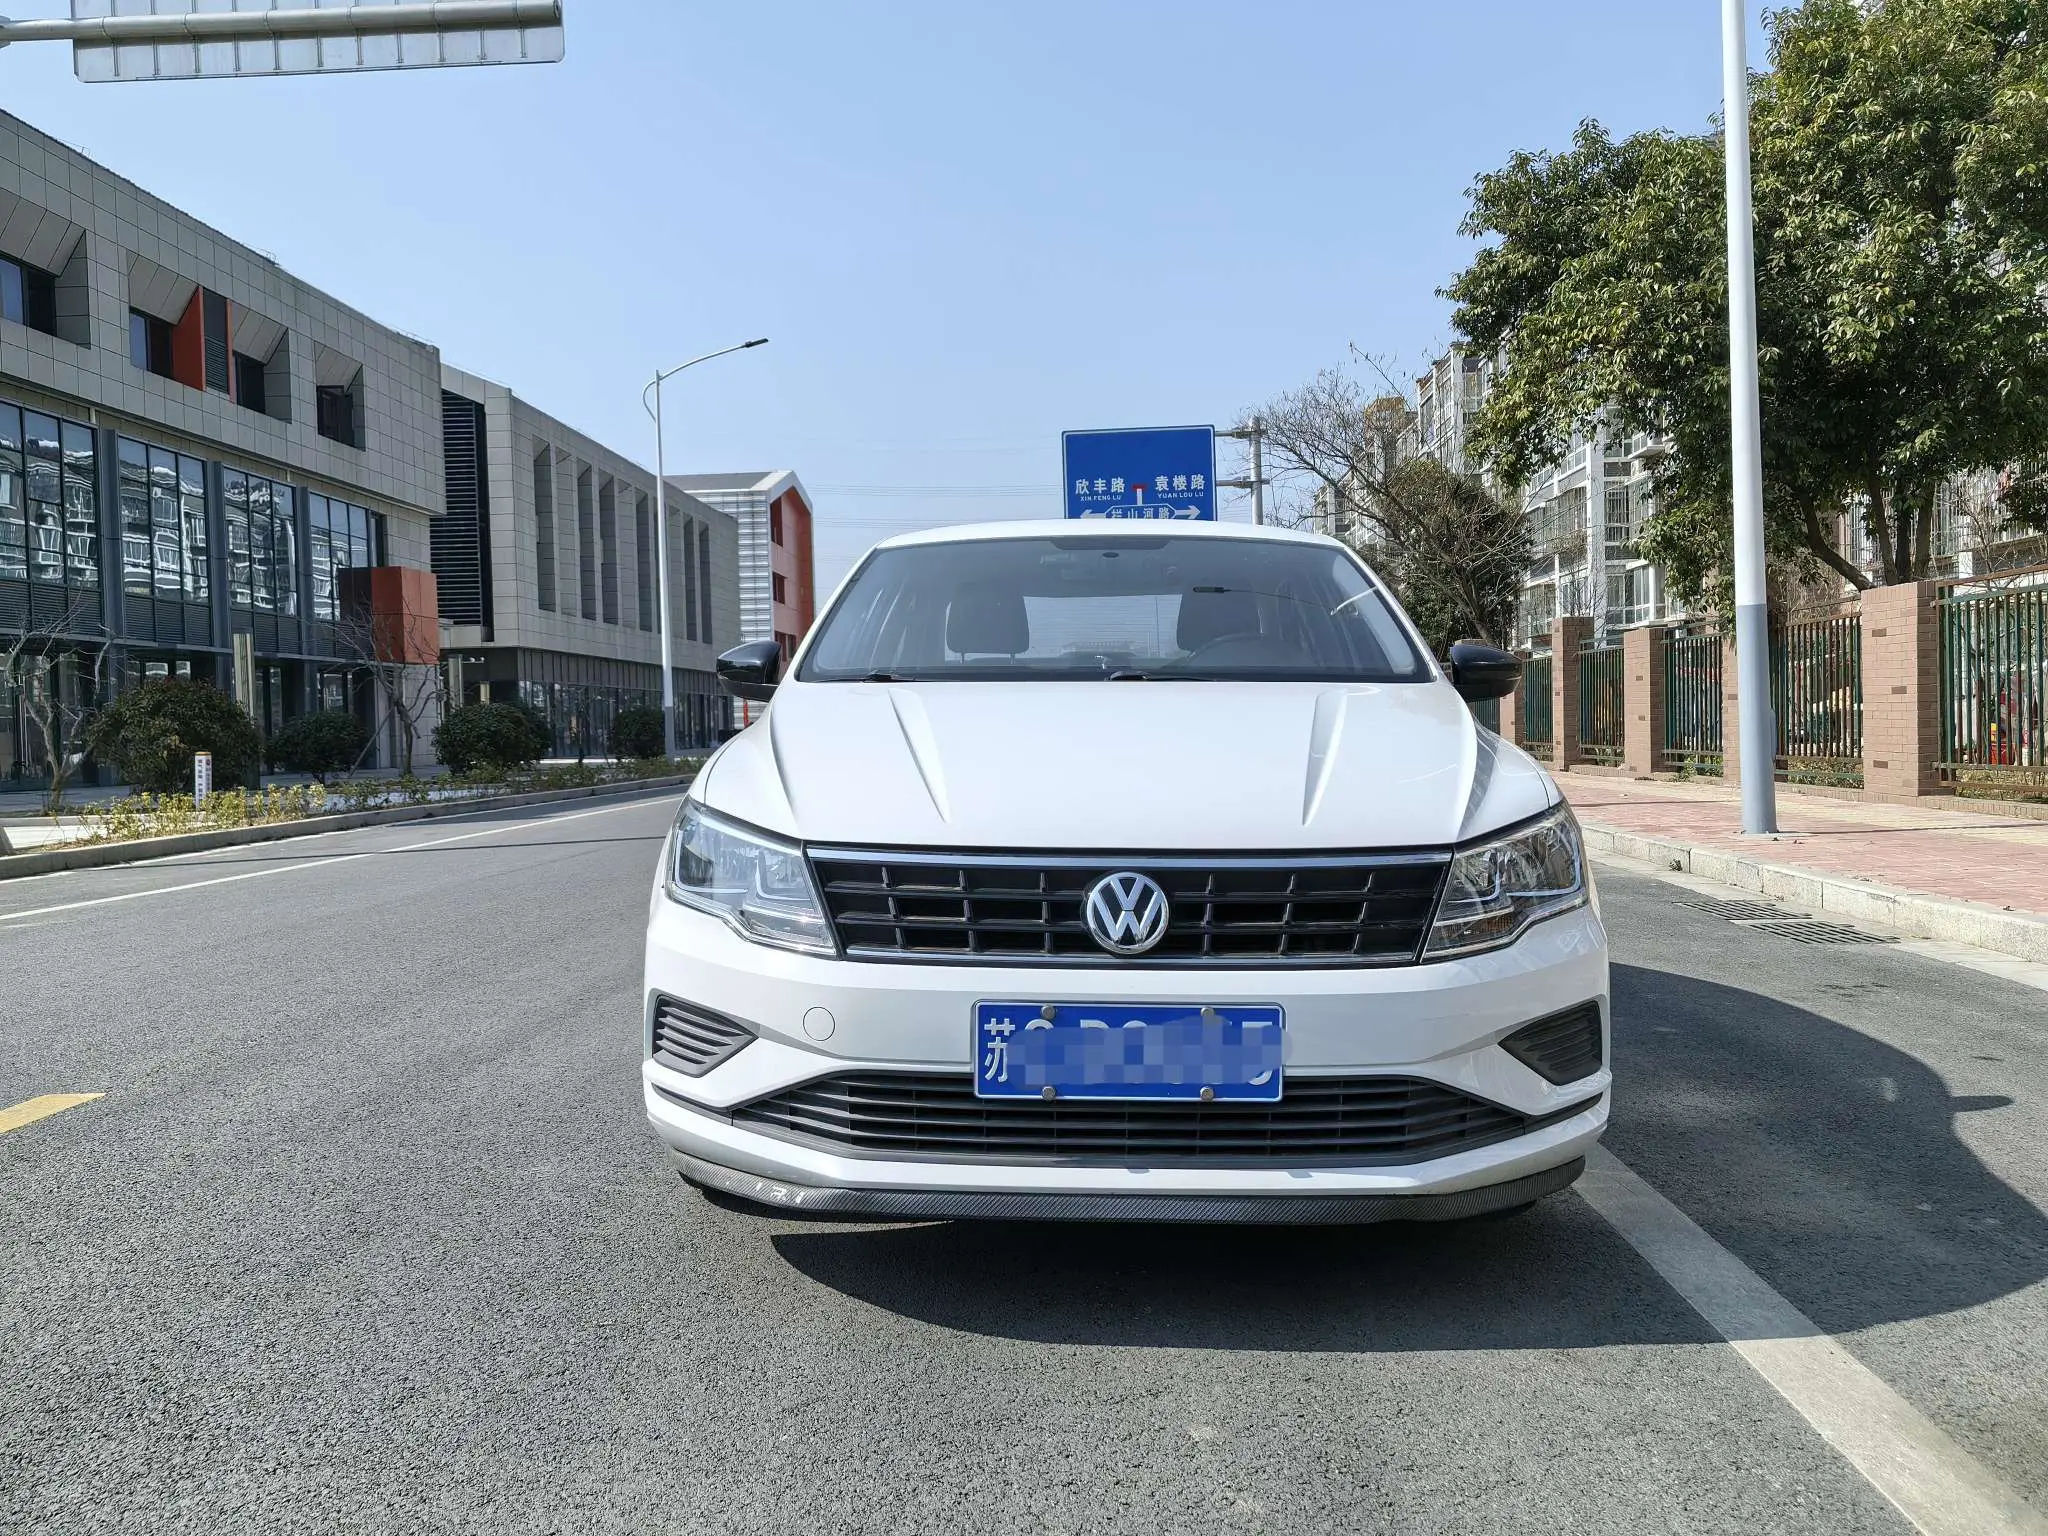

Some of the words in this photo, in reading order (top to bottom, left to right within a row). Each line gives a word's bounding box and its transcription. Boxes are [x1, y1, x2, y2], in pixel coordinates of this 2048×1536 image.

[1075, 477, 1125, 495] 欣丰路
[1154, 474, 1206, 492] 袁楼路
